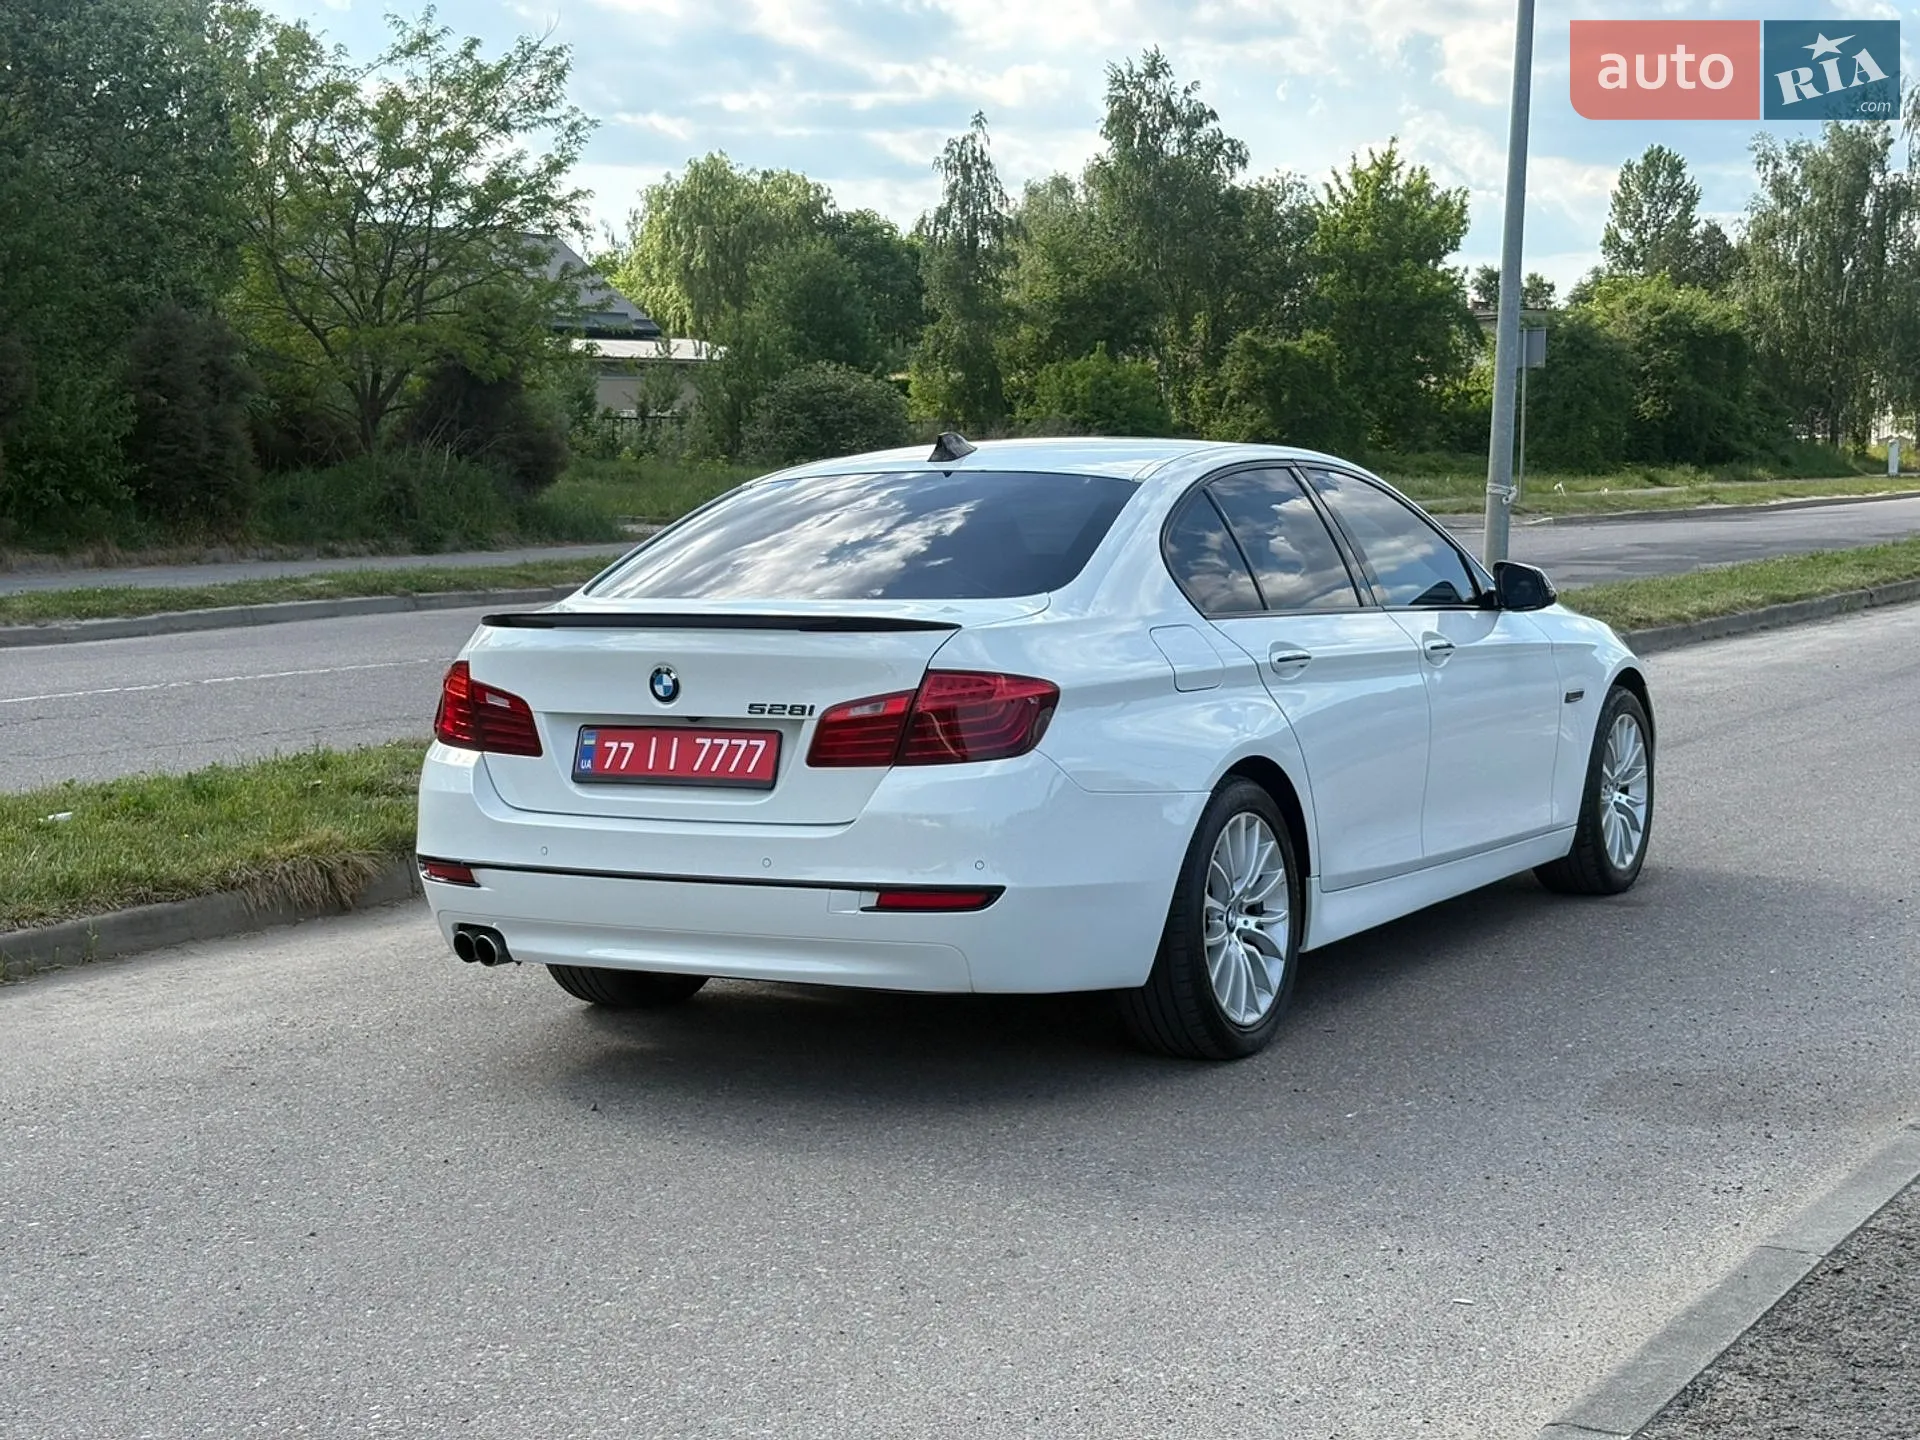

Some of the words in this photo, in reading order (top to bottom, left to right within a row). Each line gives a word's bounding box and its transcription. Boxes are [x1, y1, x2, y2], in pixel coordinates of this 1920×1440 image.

[580, 759, 592, 770] UA
[603, 741, 635, 770] 77
[692, 737, 767, 774] 7777
